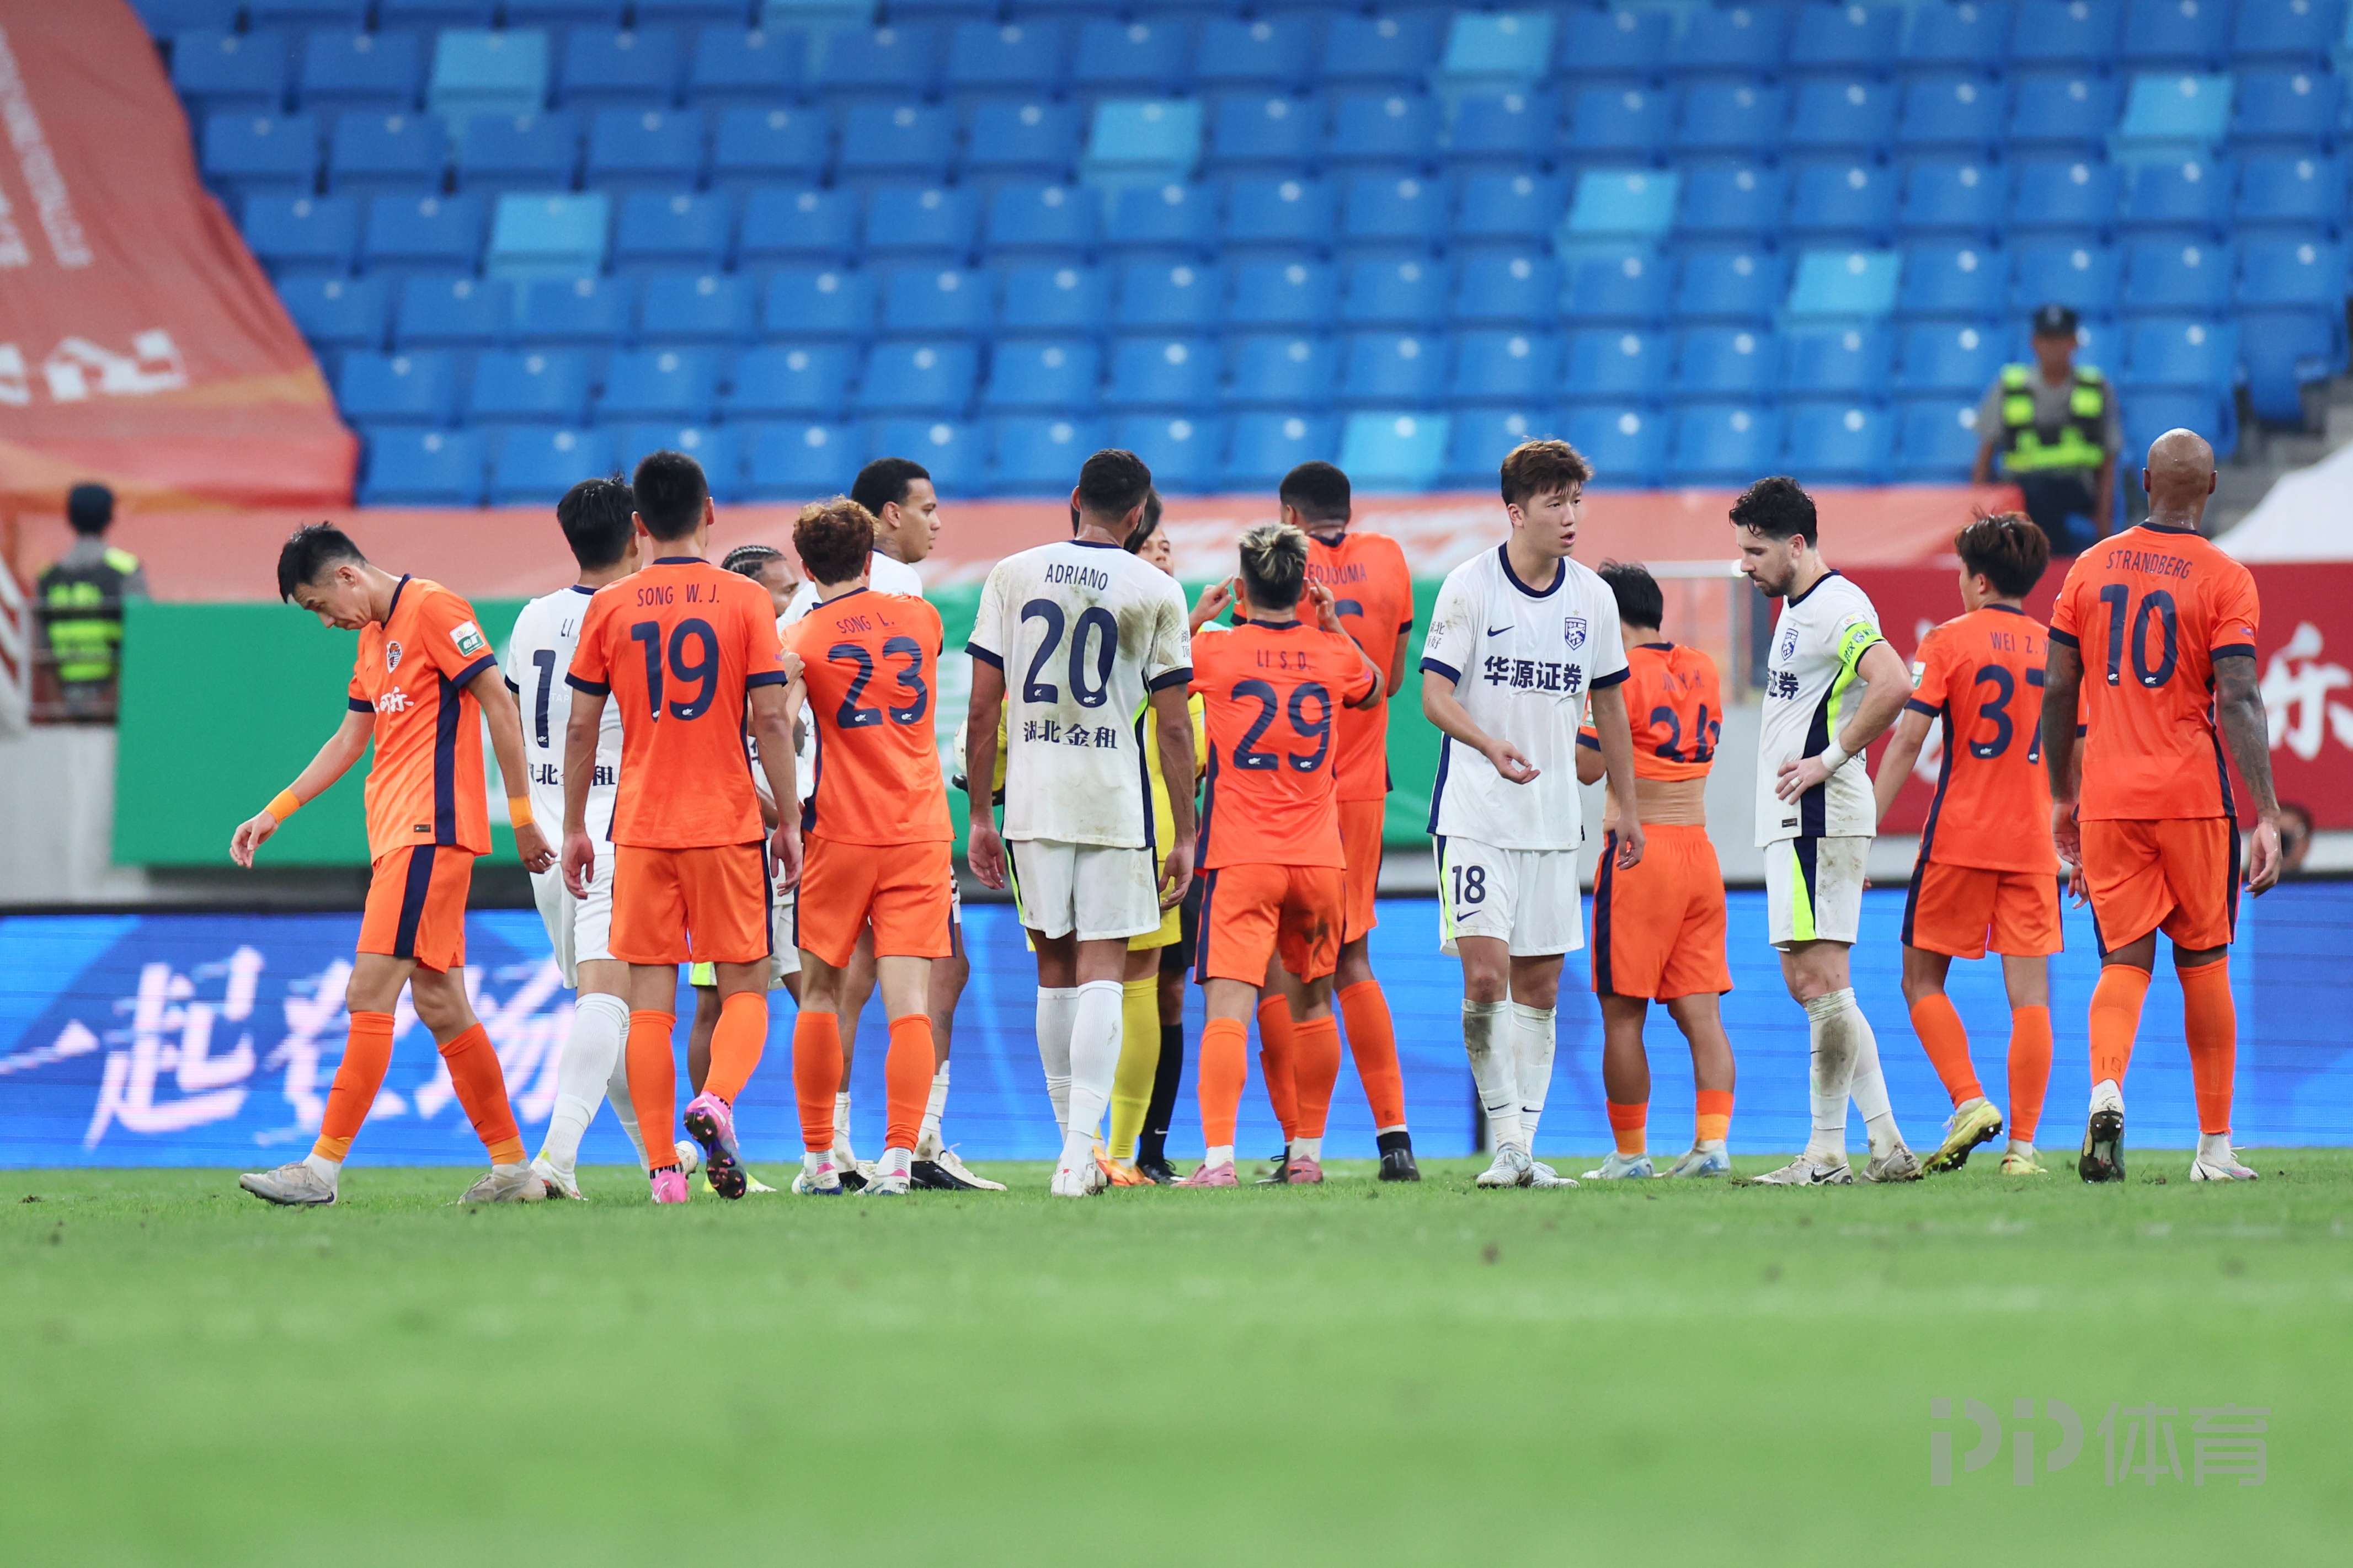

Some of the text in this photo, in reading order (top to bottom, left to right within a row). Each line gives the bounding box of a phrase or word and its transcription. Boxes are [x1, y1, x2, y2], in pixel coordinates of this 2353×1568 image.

[1044, 563, 1108, 591] ADRIANO
[2106, 550, 2193, 580] STRANDBERG
[637, 585, 674, 607] SONG
[836, 615, 872, 634] SONG
[2100, 584, 2178, 689] 10
[1021, 598, 1118, 708] 20
[1257, 649, 1269, 667] LI
[1991, 632, 2015, 652] WEI
[631, 618, 719, 724] 19
[827, 635, 928, 729] 23
[1484, 655, 1582, 693] 华源证券
[1231, 679, 1332, 773] 29
[1969, 664, 2045, 765] 37
[1023, 719, 1118, 749] 湖北金租
[527, 763, 616, 786] 北租
[1452, 865, 1486, 905] 18
